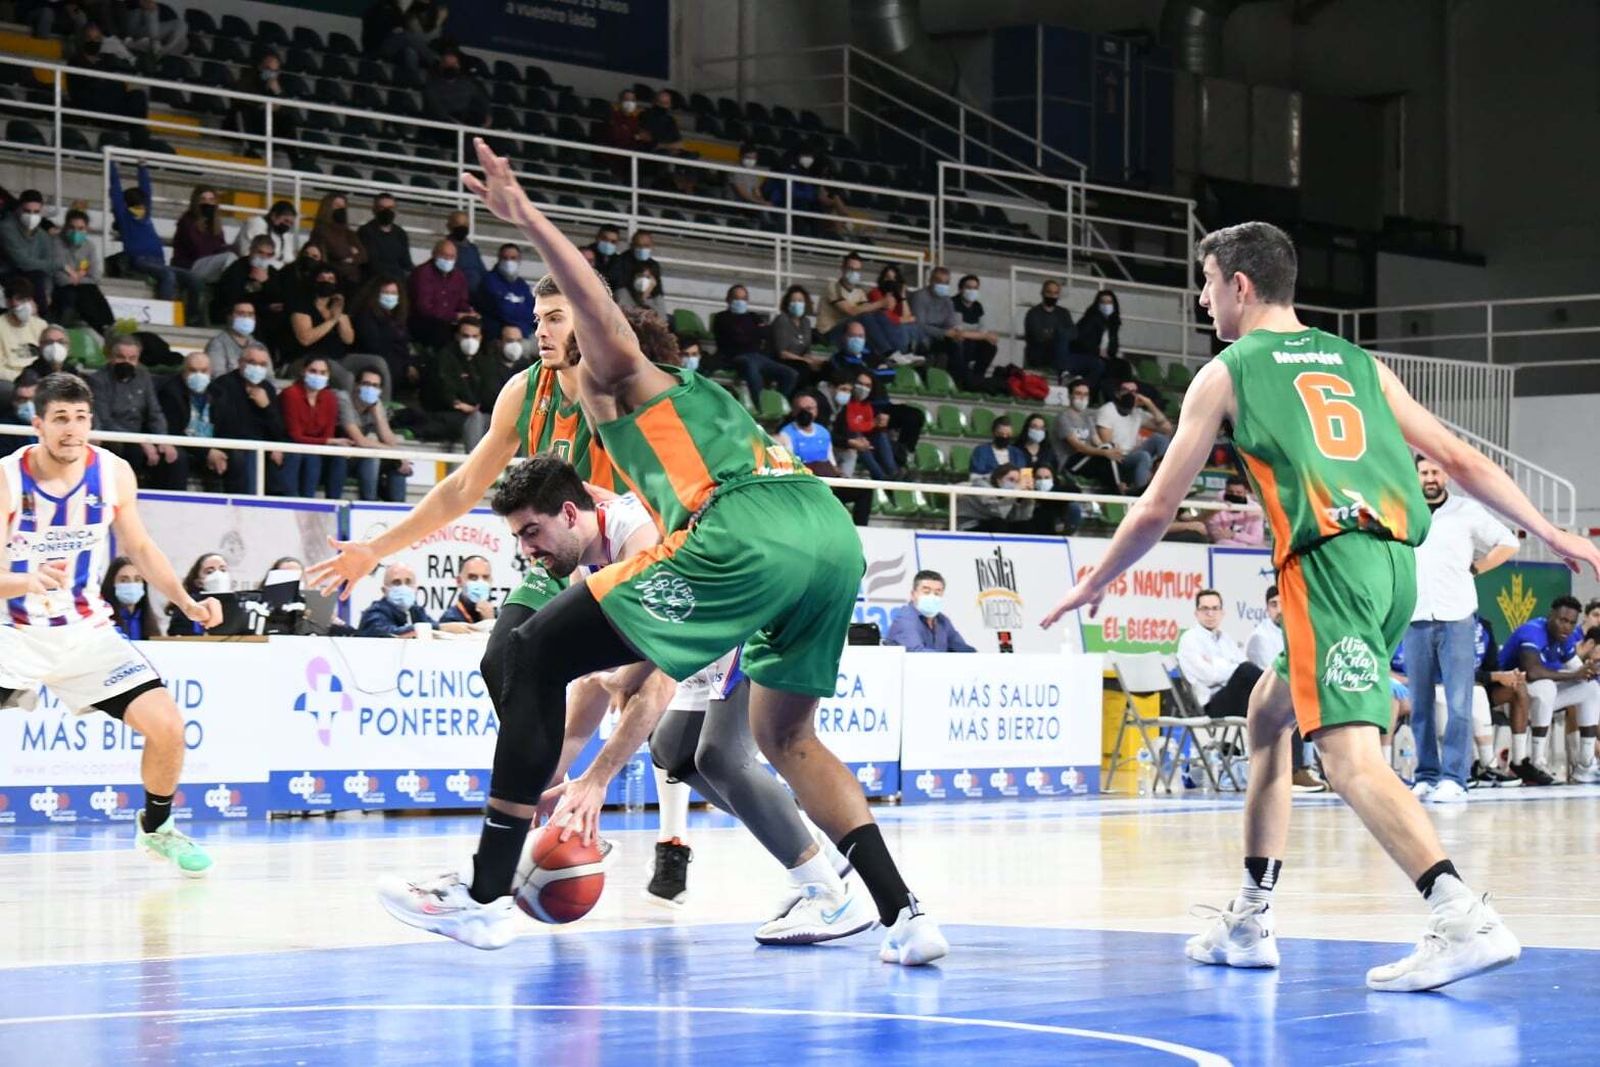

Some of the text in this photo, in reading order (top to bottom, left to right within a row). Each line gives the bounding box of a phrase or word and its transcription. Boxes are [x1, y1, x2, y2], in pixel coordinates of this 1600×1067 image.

[1293, 371, 1367, 462] 6
[1103, 616, 1179, 642] EL BIERZO
[103, 663, 147, 687] COSMOS
[948, 677, 1060, 708] MÁS SALUD
[22, 711, 204, 751] MÁS BIEO
[359, 707, 499, 736] PONFERRA
[948, 712, 1061, 741] MÁS BIERZO
